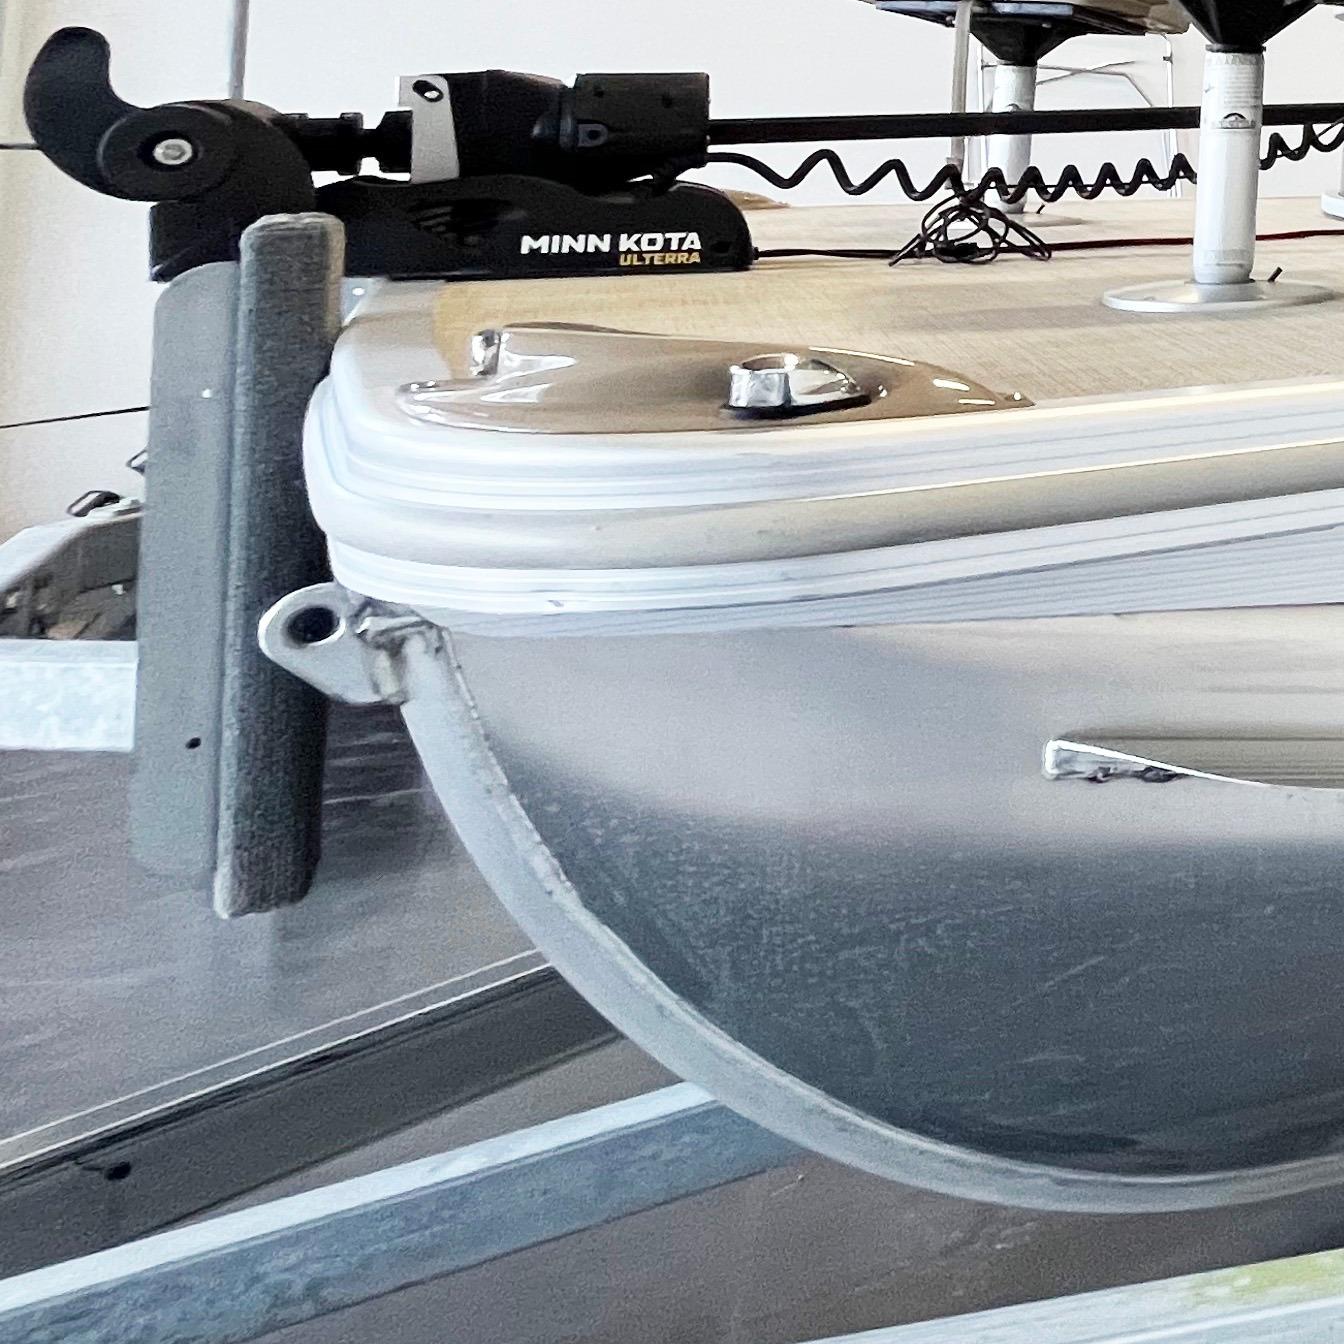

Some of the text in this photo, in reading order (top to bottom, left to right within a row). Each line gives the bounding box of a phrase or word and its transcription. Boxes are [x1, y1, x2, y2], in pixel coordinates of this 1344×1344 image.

[519, 231, 703, 255] MINN KOTA
[619, 251, 701, 266] ULTERRA
